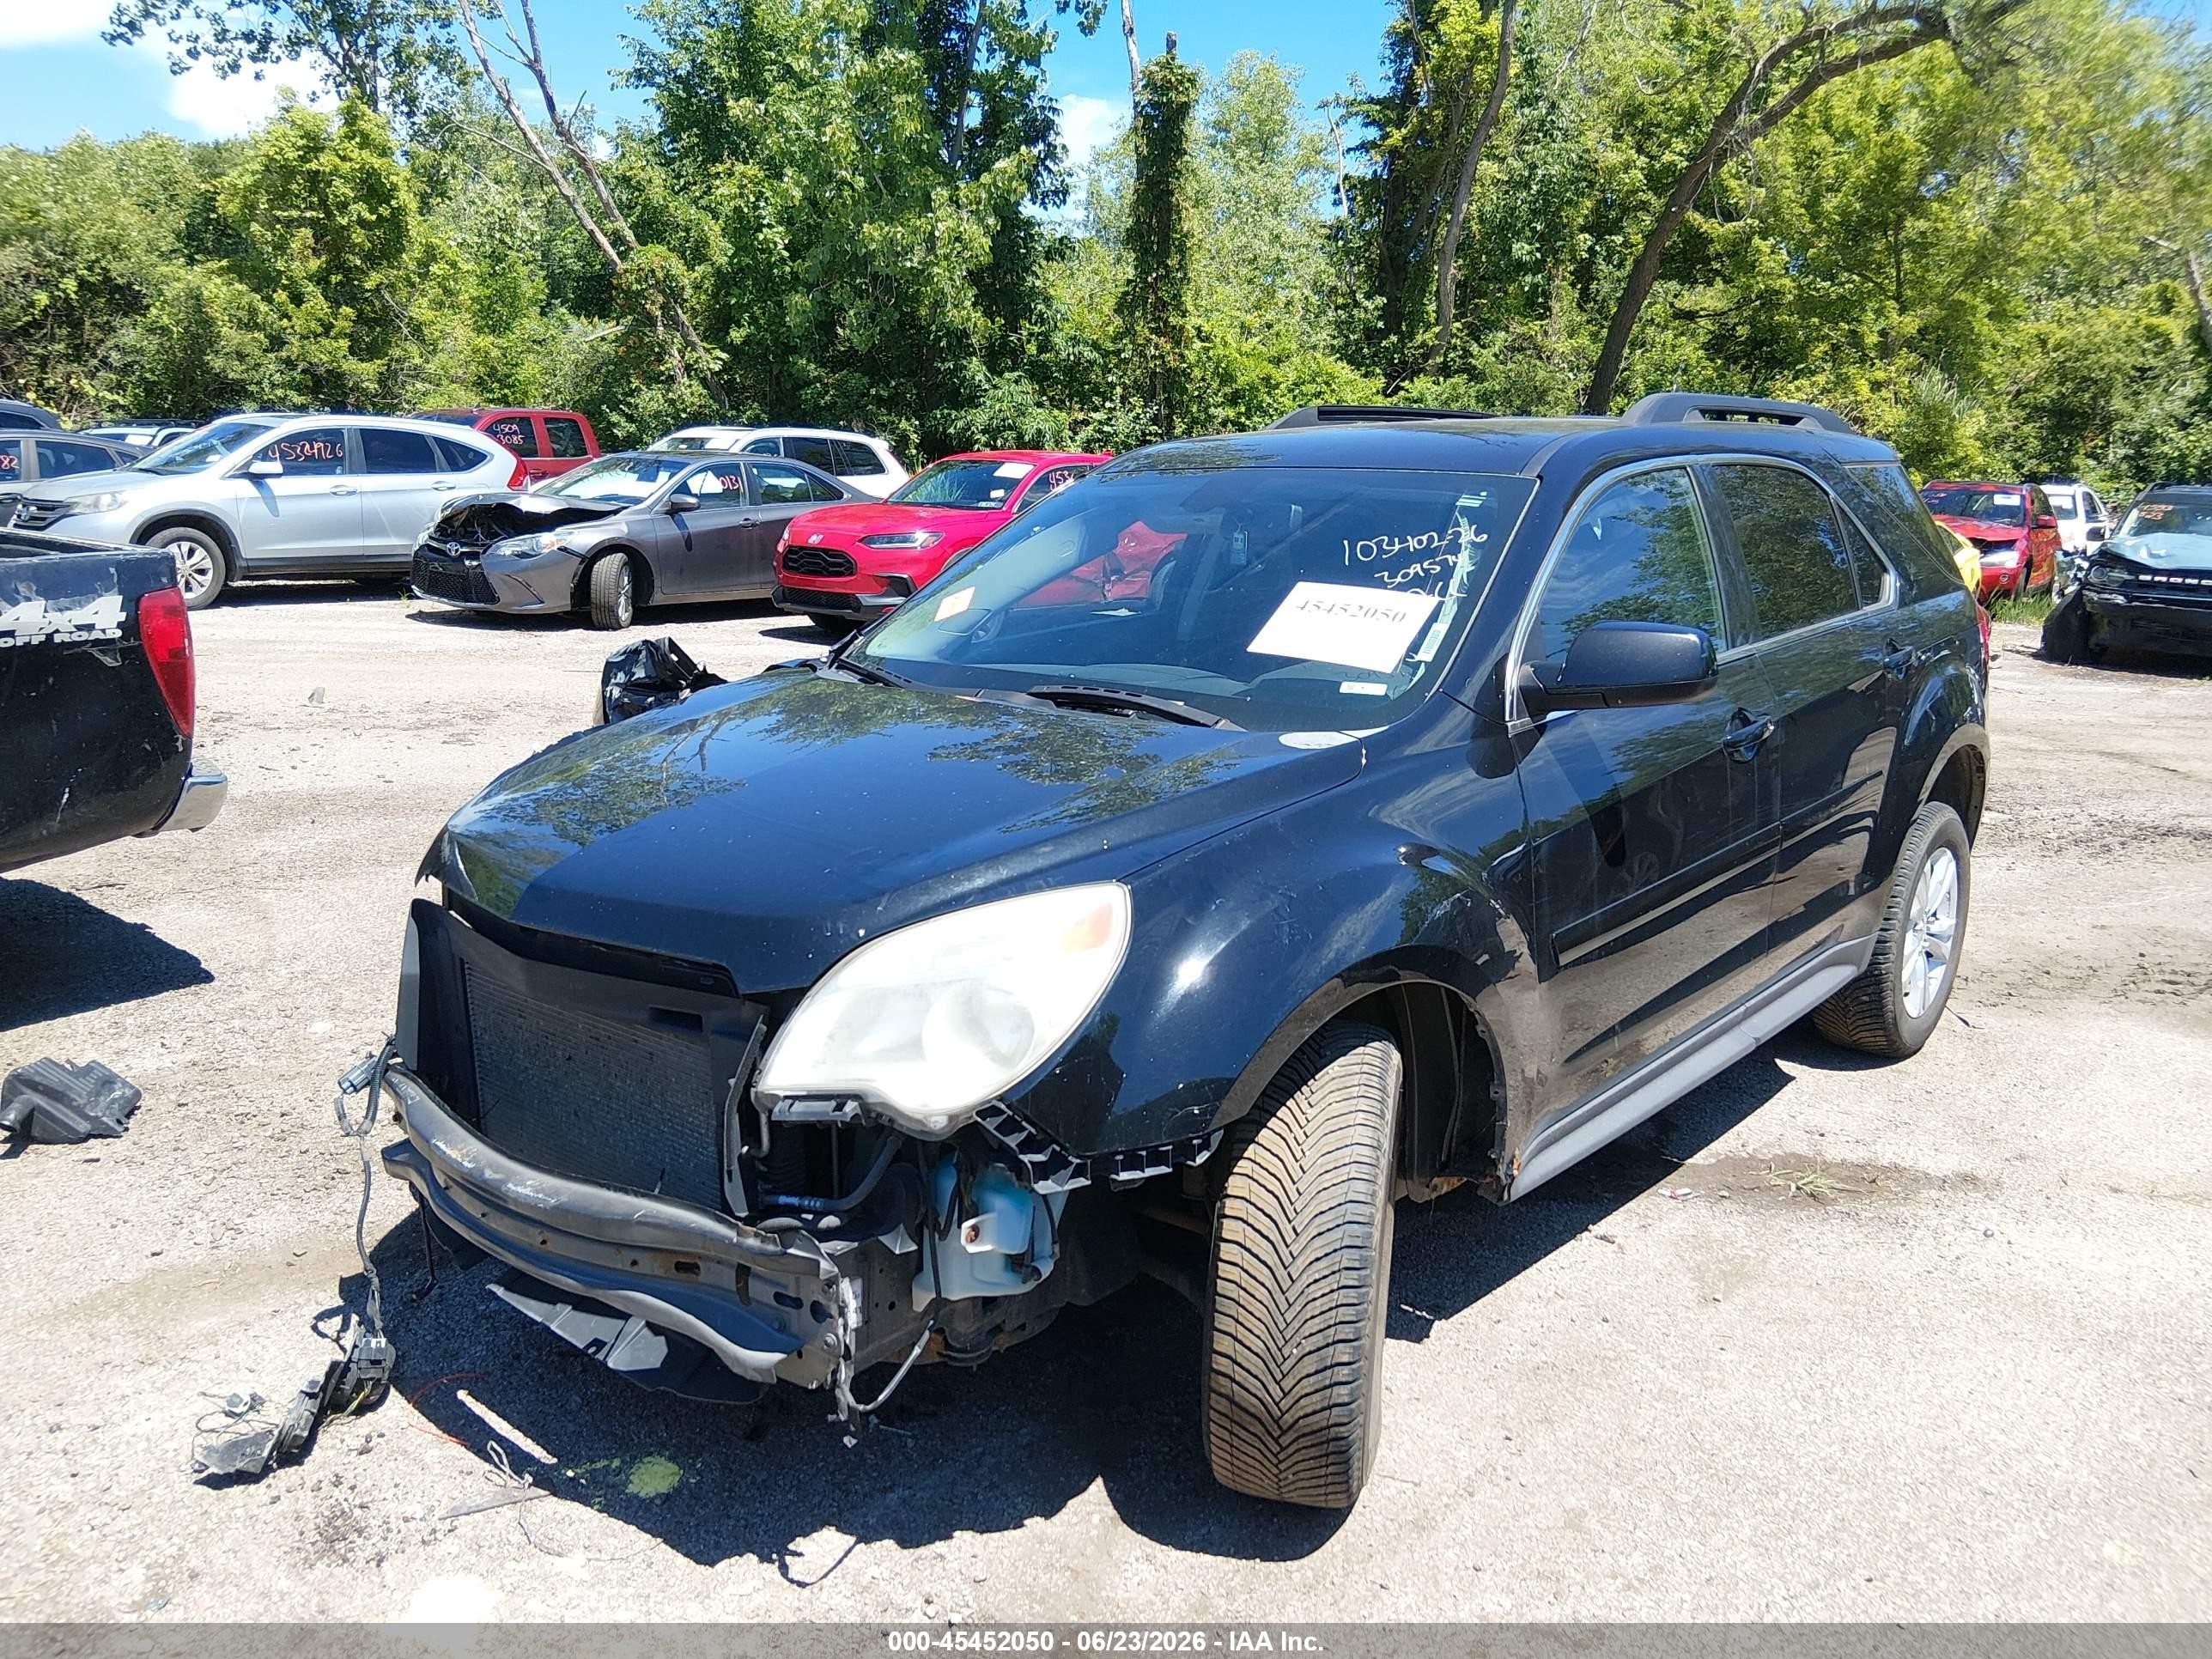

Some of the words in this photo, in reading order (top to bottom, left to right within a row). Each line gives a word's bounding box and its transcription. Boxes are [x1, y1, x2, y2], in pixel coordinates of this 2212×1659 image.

[496, 434, 526, 445] 3085
[1295, 599, 1407, 623] 45452050
[0, 633, 46, 648] OFF
[53, 628, 123, 643] ROAD
